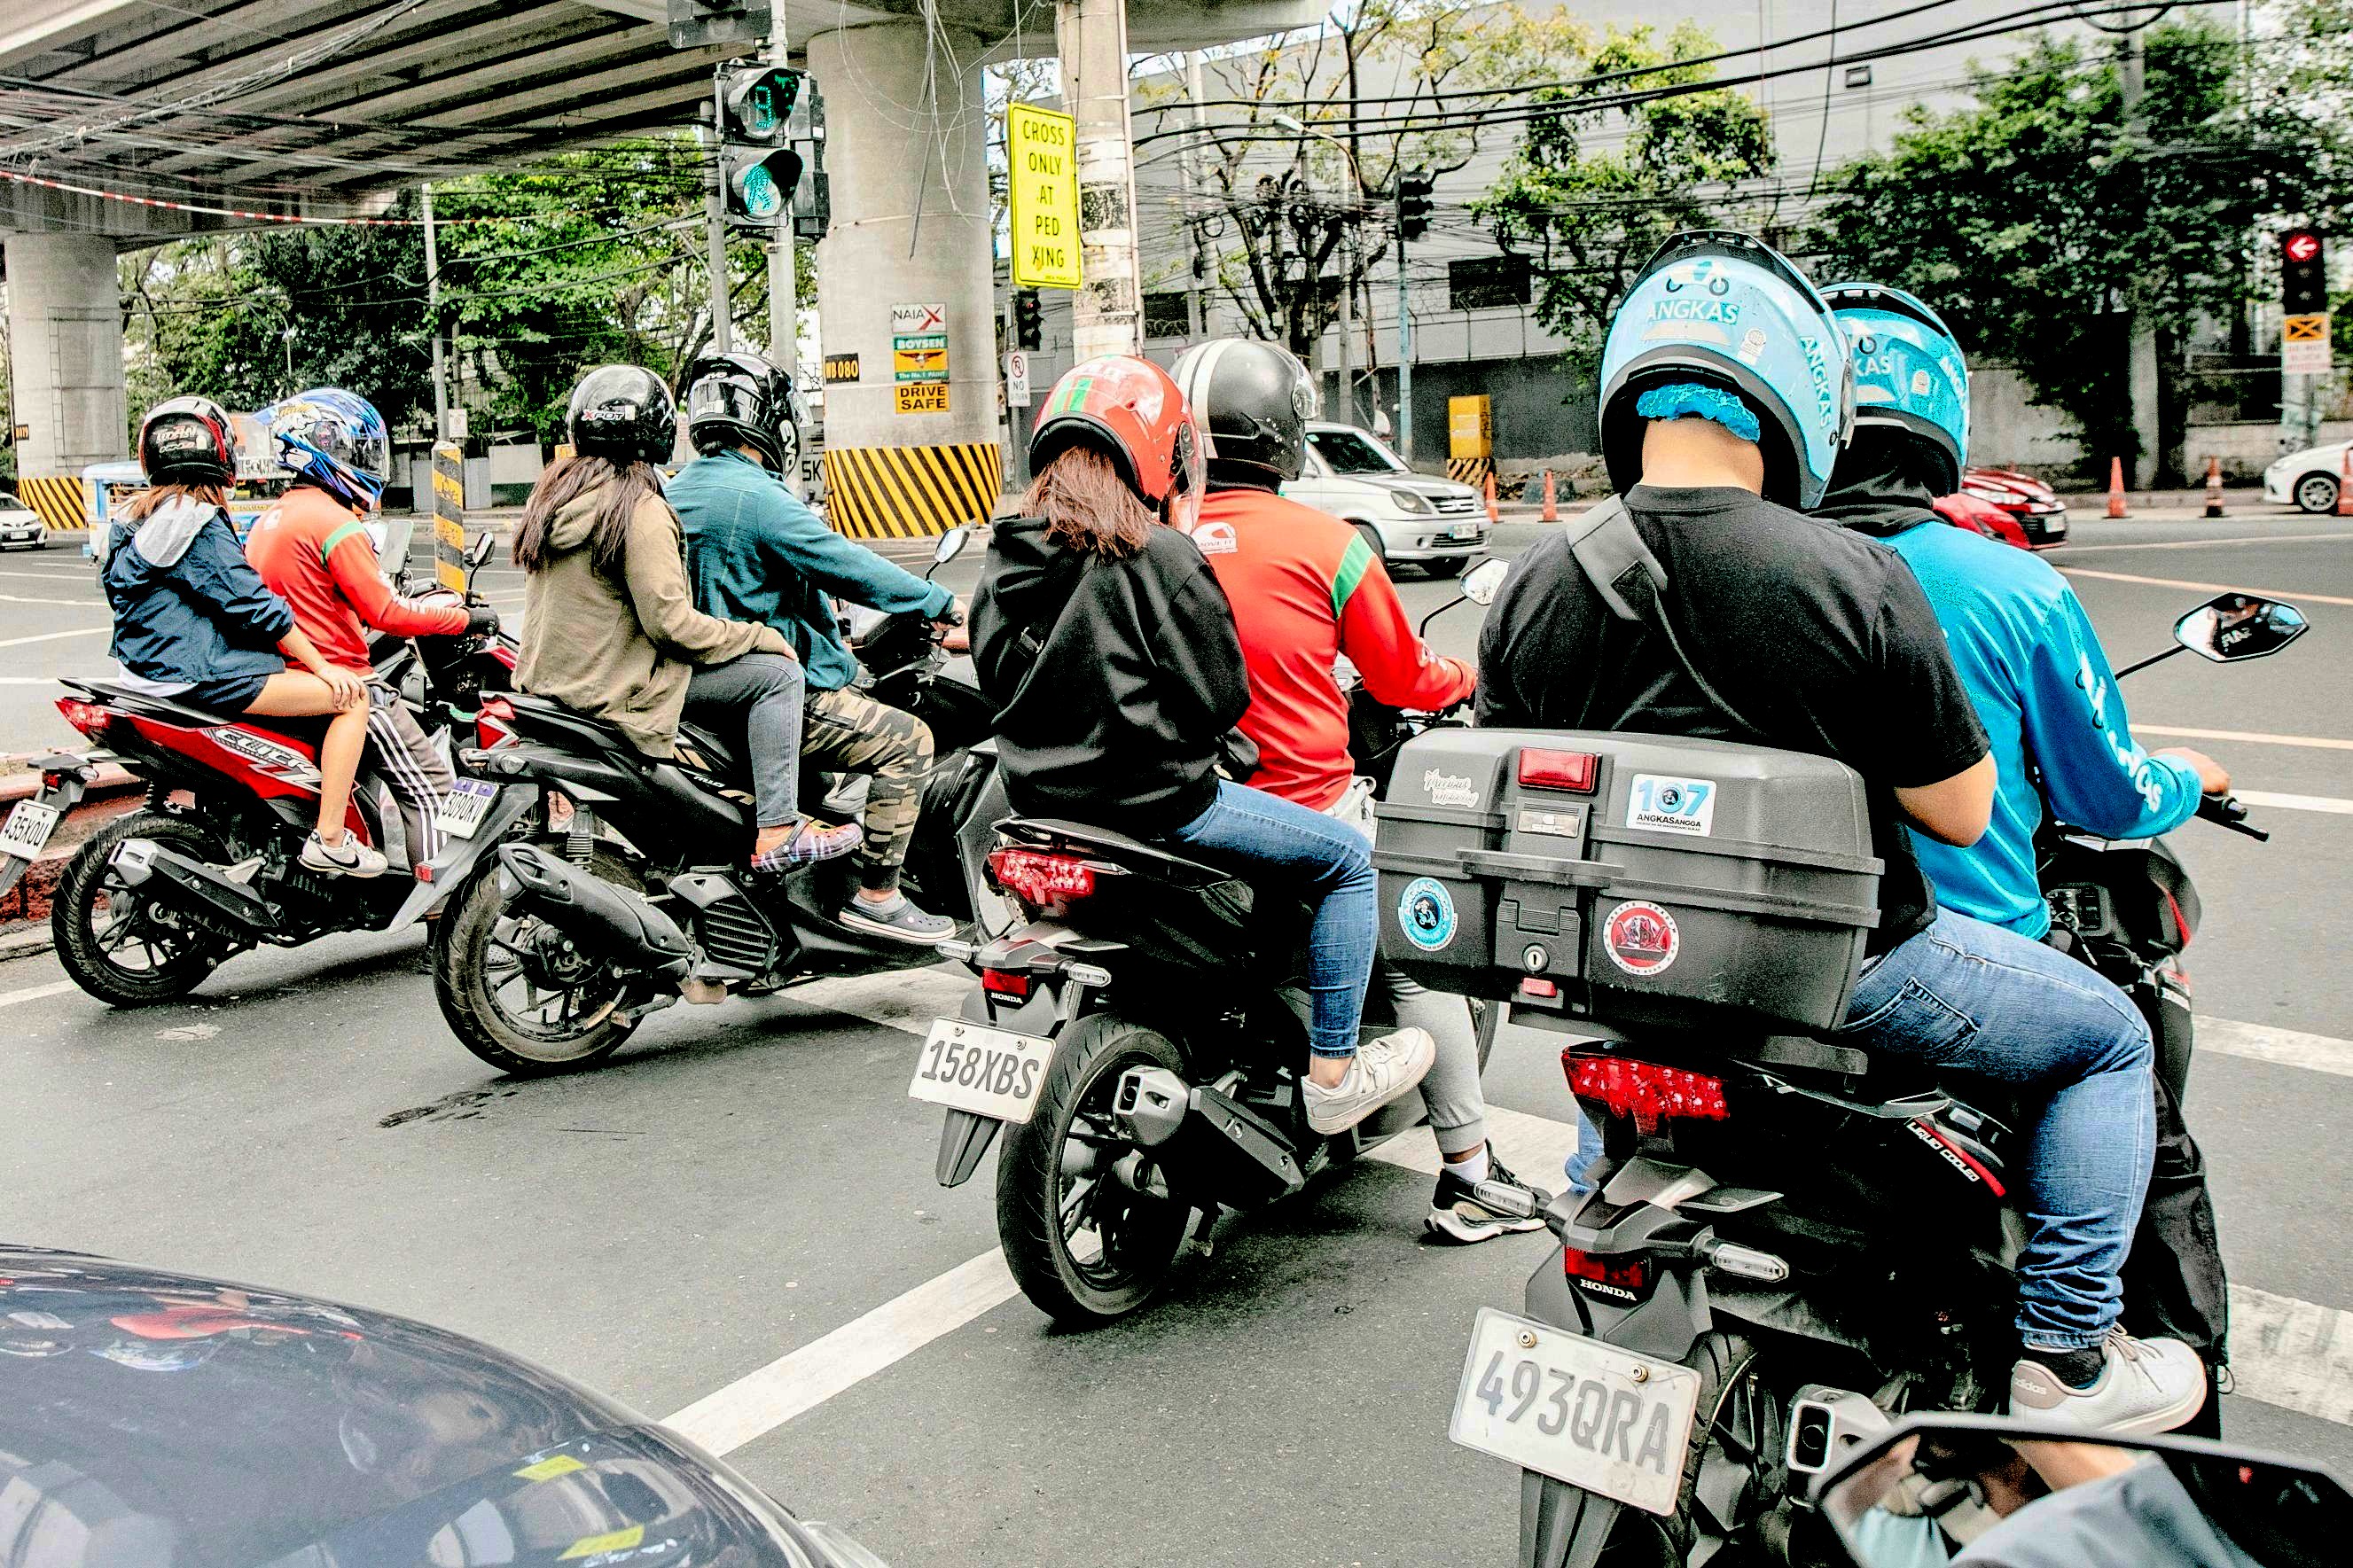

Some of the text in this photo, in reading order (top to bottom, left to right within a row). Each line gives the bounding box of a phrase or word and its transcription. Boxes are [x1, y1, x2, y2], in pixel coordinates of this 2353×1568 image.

[1023, 120, 1065, 146] CROSS
[1028, 152, 1062, 176] ONLY
[1039, 184, 1053, 206] AT
[1036, 215, 1060, 236] PED
[1032, 246, 1065, 268] XING
[1646, 300, 1739, 325] ANGKAS
[896, 339, 945, 349] BOYSEN
[900, 386, 946, 398] DRIVE
[1012, 380, 1025, 391] NO
[1799, 336, 1832, 428] ANGKAS
[901, 398, 946, 410] SAFE
[802, 459, 825, 481] SK
[4, 815, 50, 846] 435XOU
[990, 992, 1024, 1004] HONDA
[921, 1040, 1040, 1099] 158XBS
[1906, 1121, 1981, 1182] LIQUID COOLED
[1580, 1278, 1638, 1301] HONDA
[1475, 1350, 1670, 1475] 493QRA
